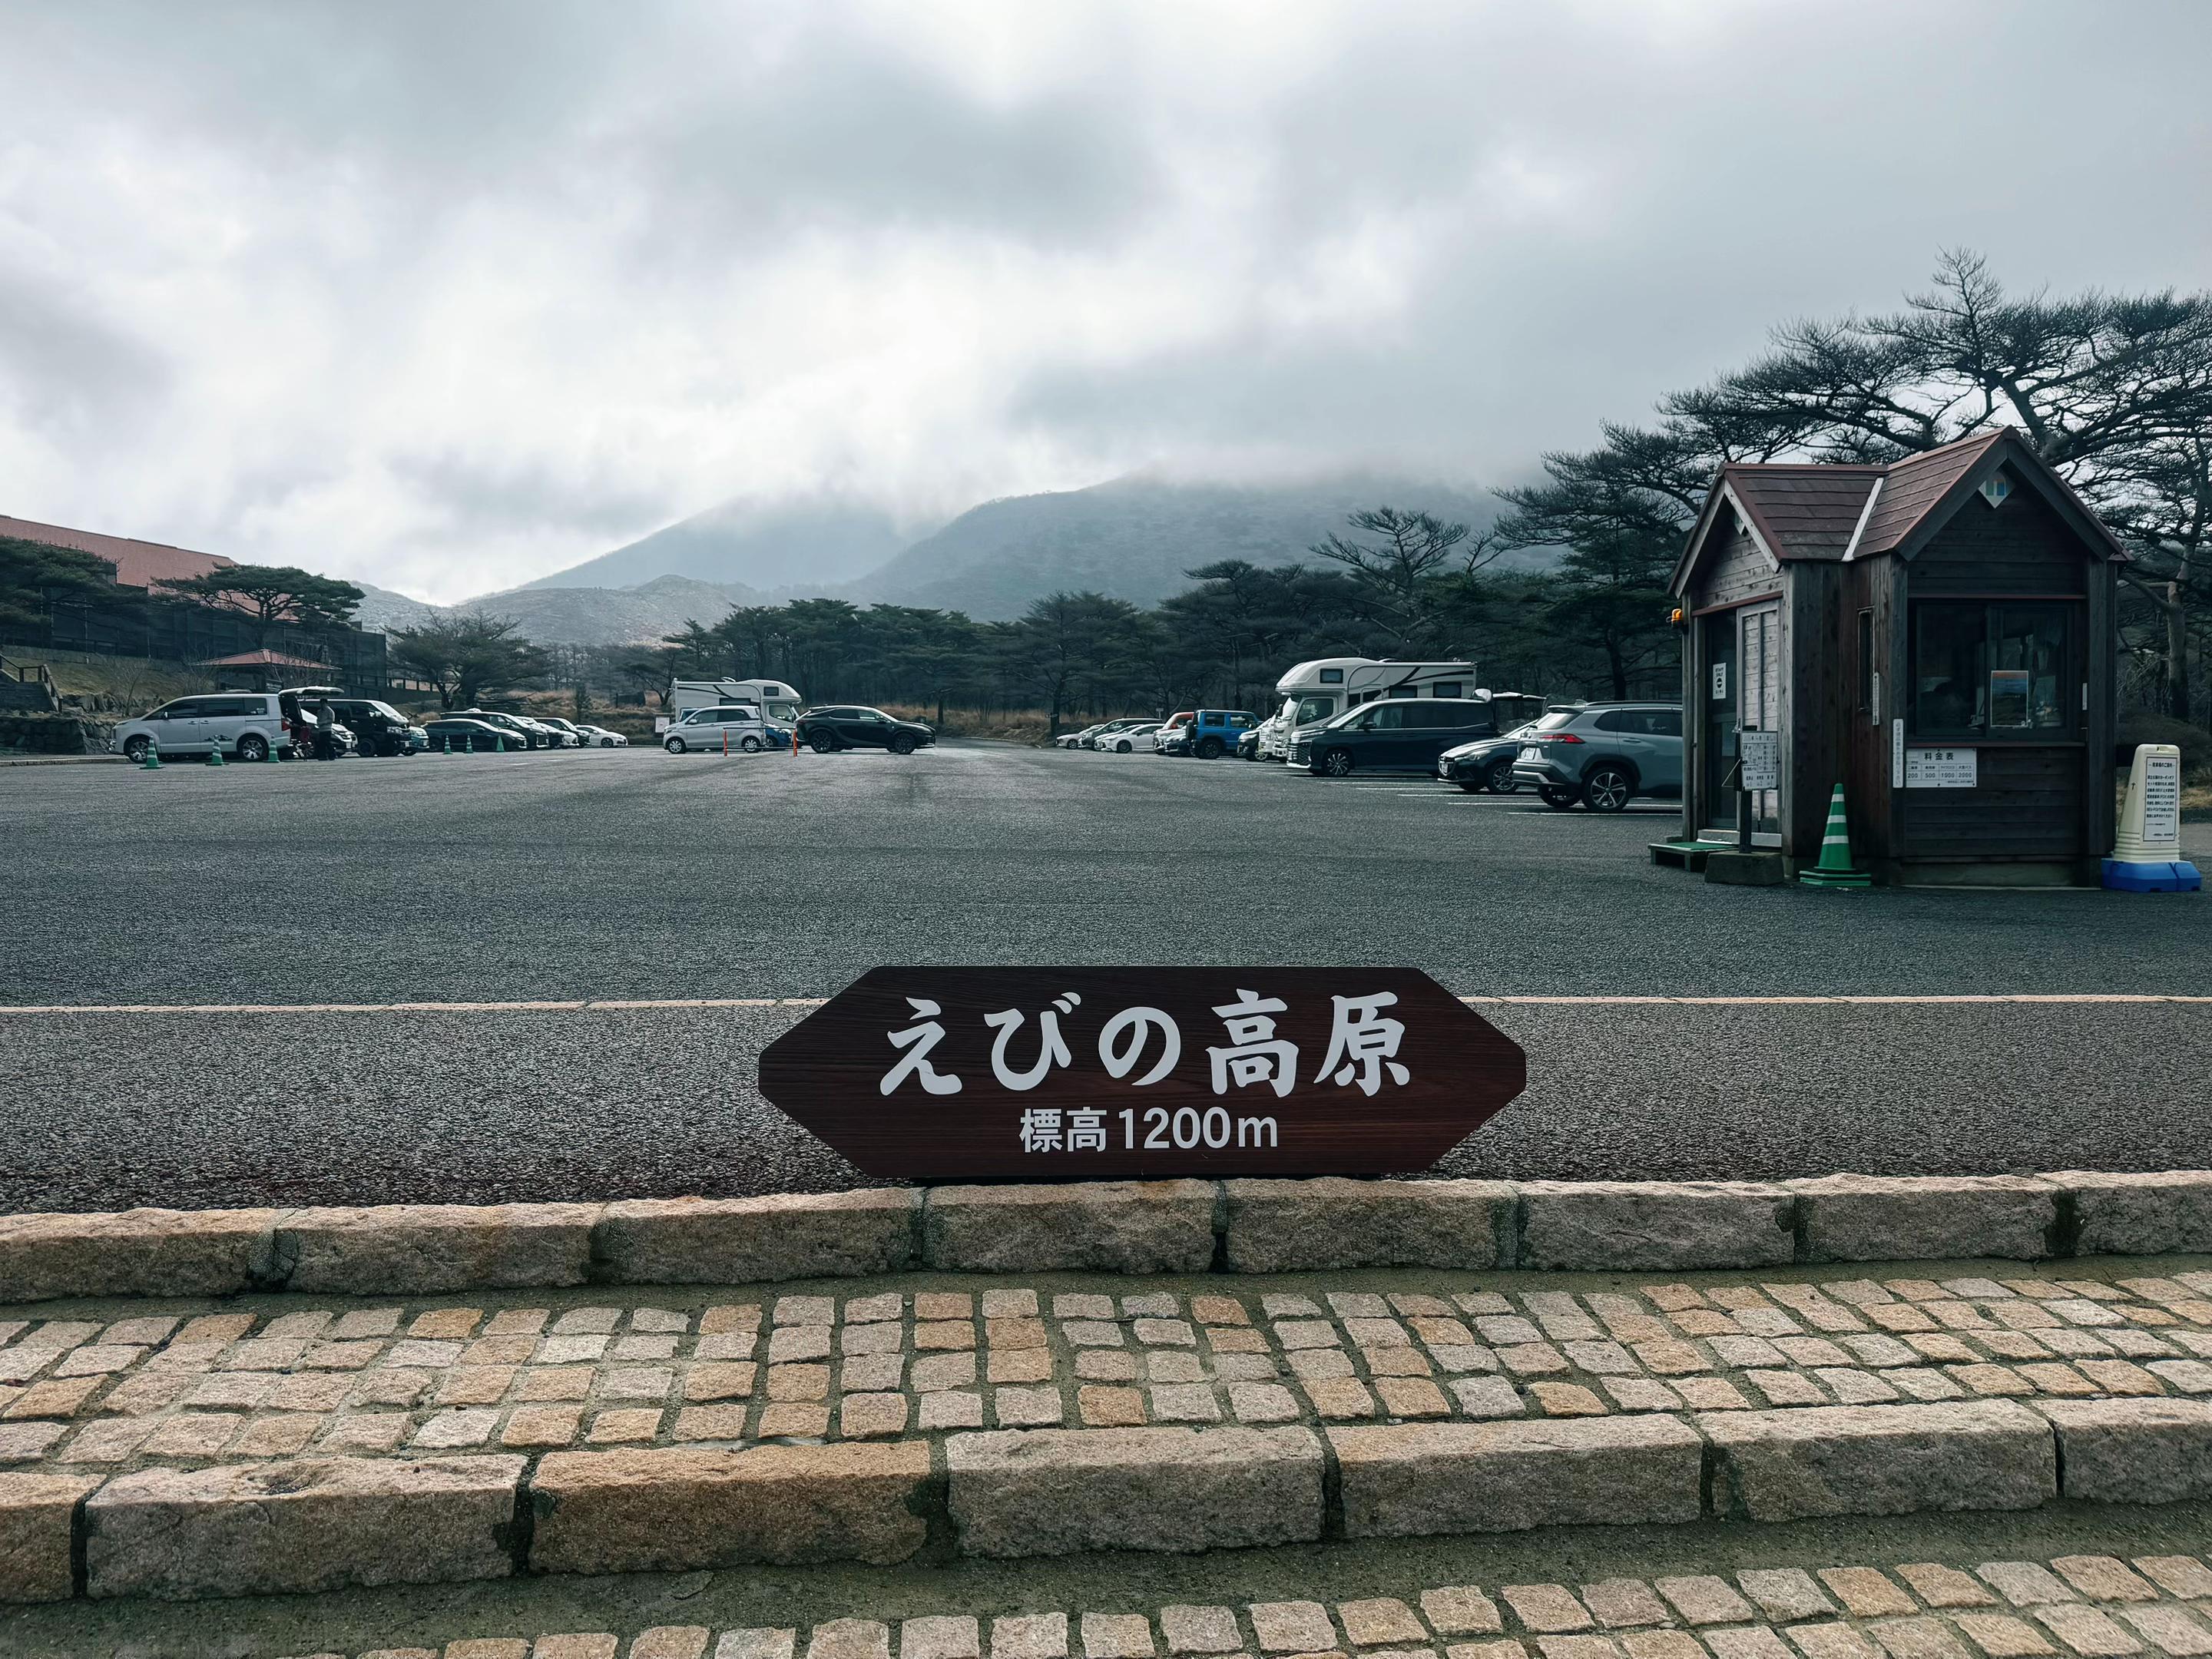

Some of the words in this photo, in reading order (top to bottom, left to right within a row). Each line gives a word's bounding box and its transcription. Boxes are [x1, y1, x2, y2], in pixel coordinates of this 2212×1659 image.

[880, 988, 1410, 1098] えびの高原
[1018, 1106, 1278, 1154] 標高1200m
